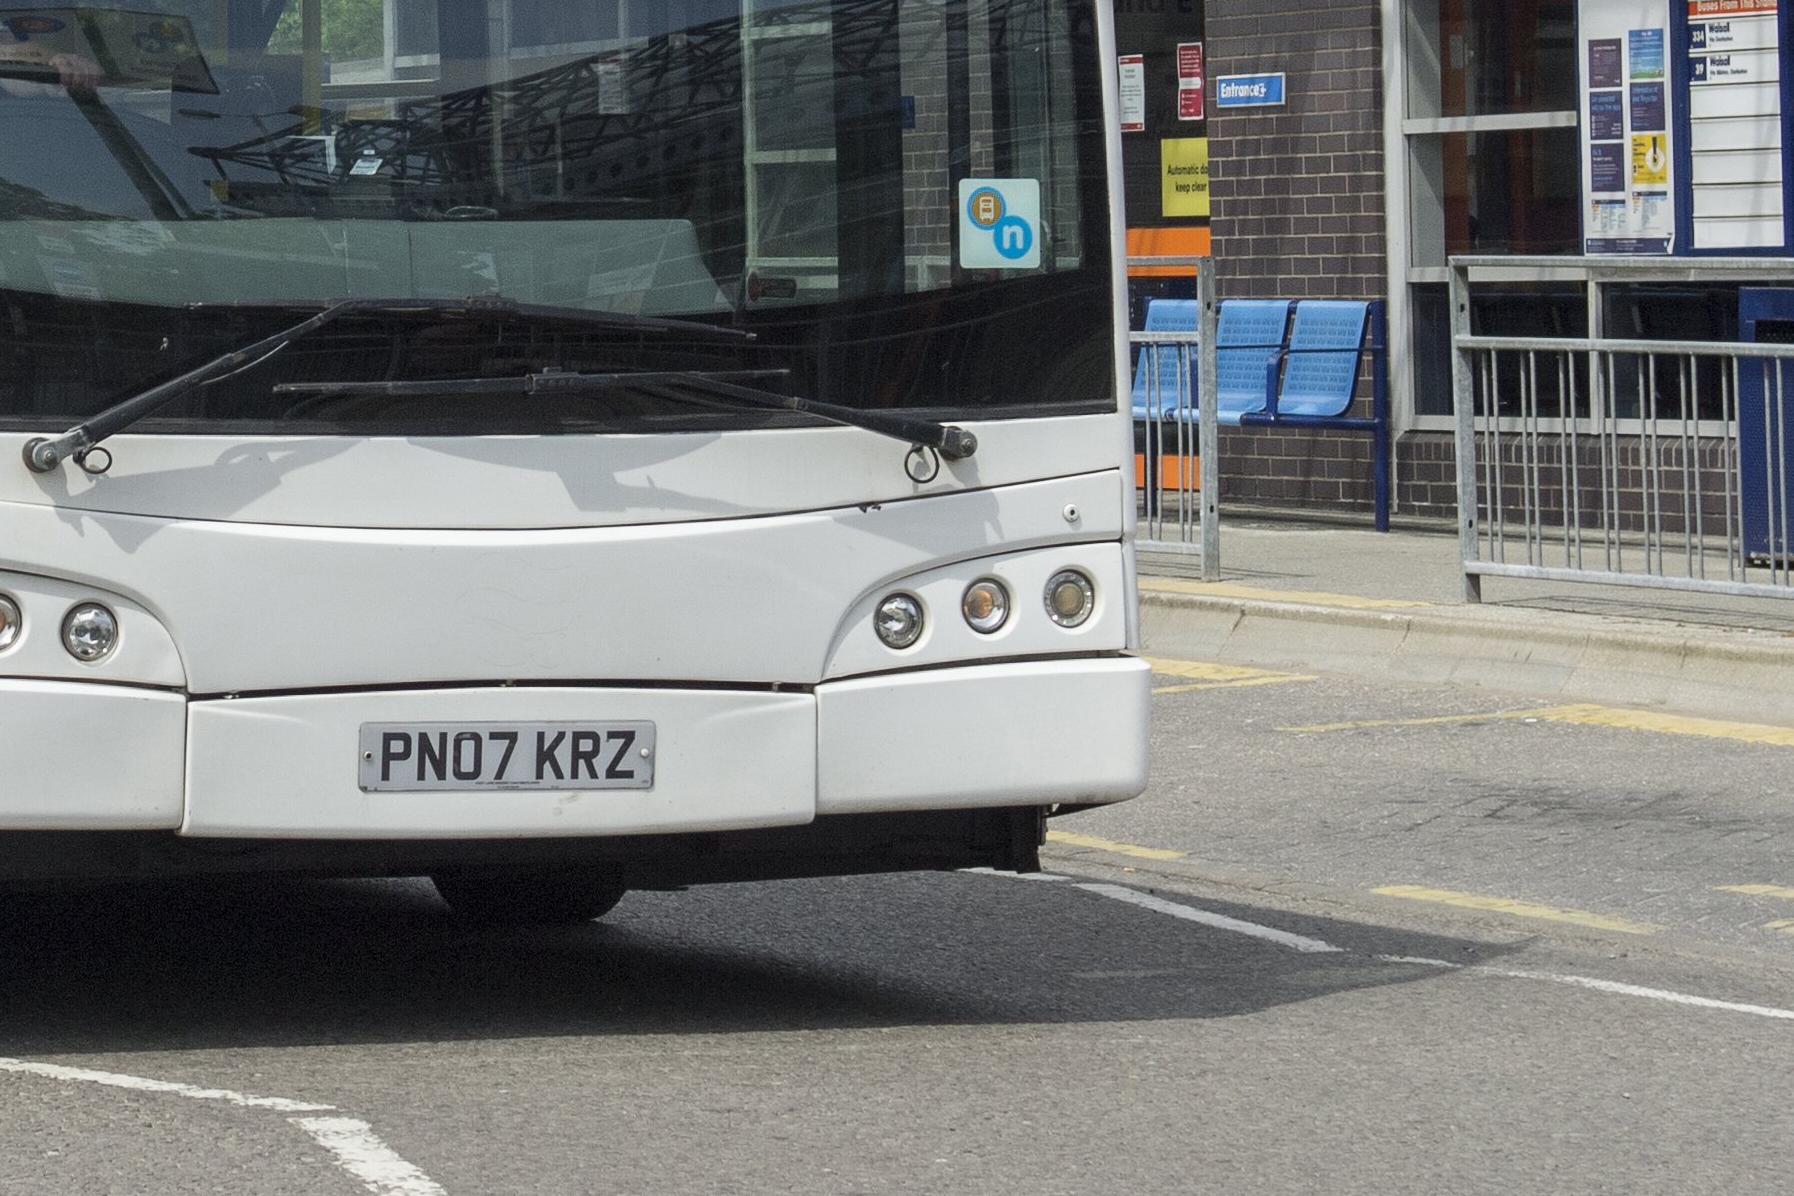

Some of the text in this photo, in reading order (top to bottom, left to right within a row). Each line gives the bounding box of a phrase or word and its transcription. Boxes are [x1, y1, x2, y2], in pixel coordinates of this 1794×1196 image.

[1220, 82, 1260, 99] Entrance
[1167, 164, 1199, 175] Automatic
[1175, 182, 1191, 194] keep
[380, 730, 637, 782] PN07 KRZ
